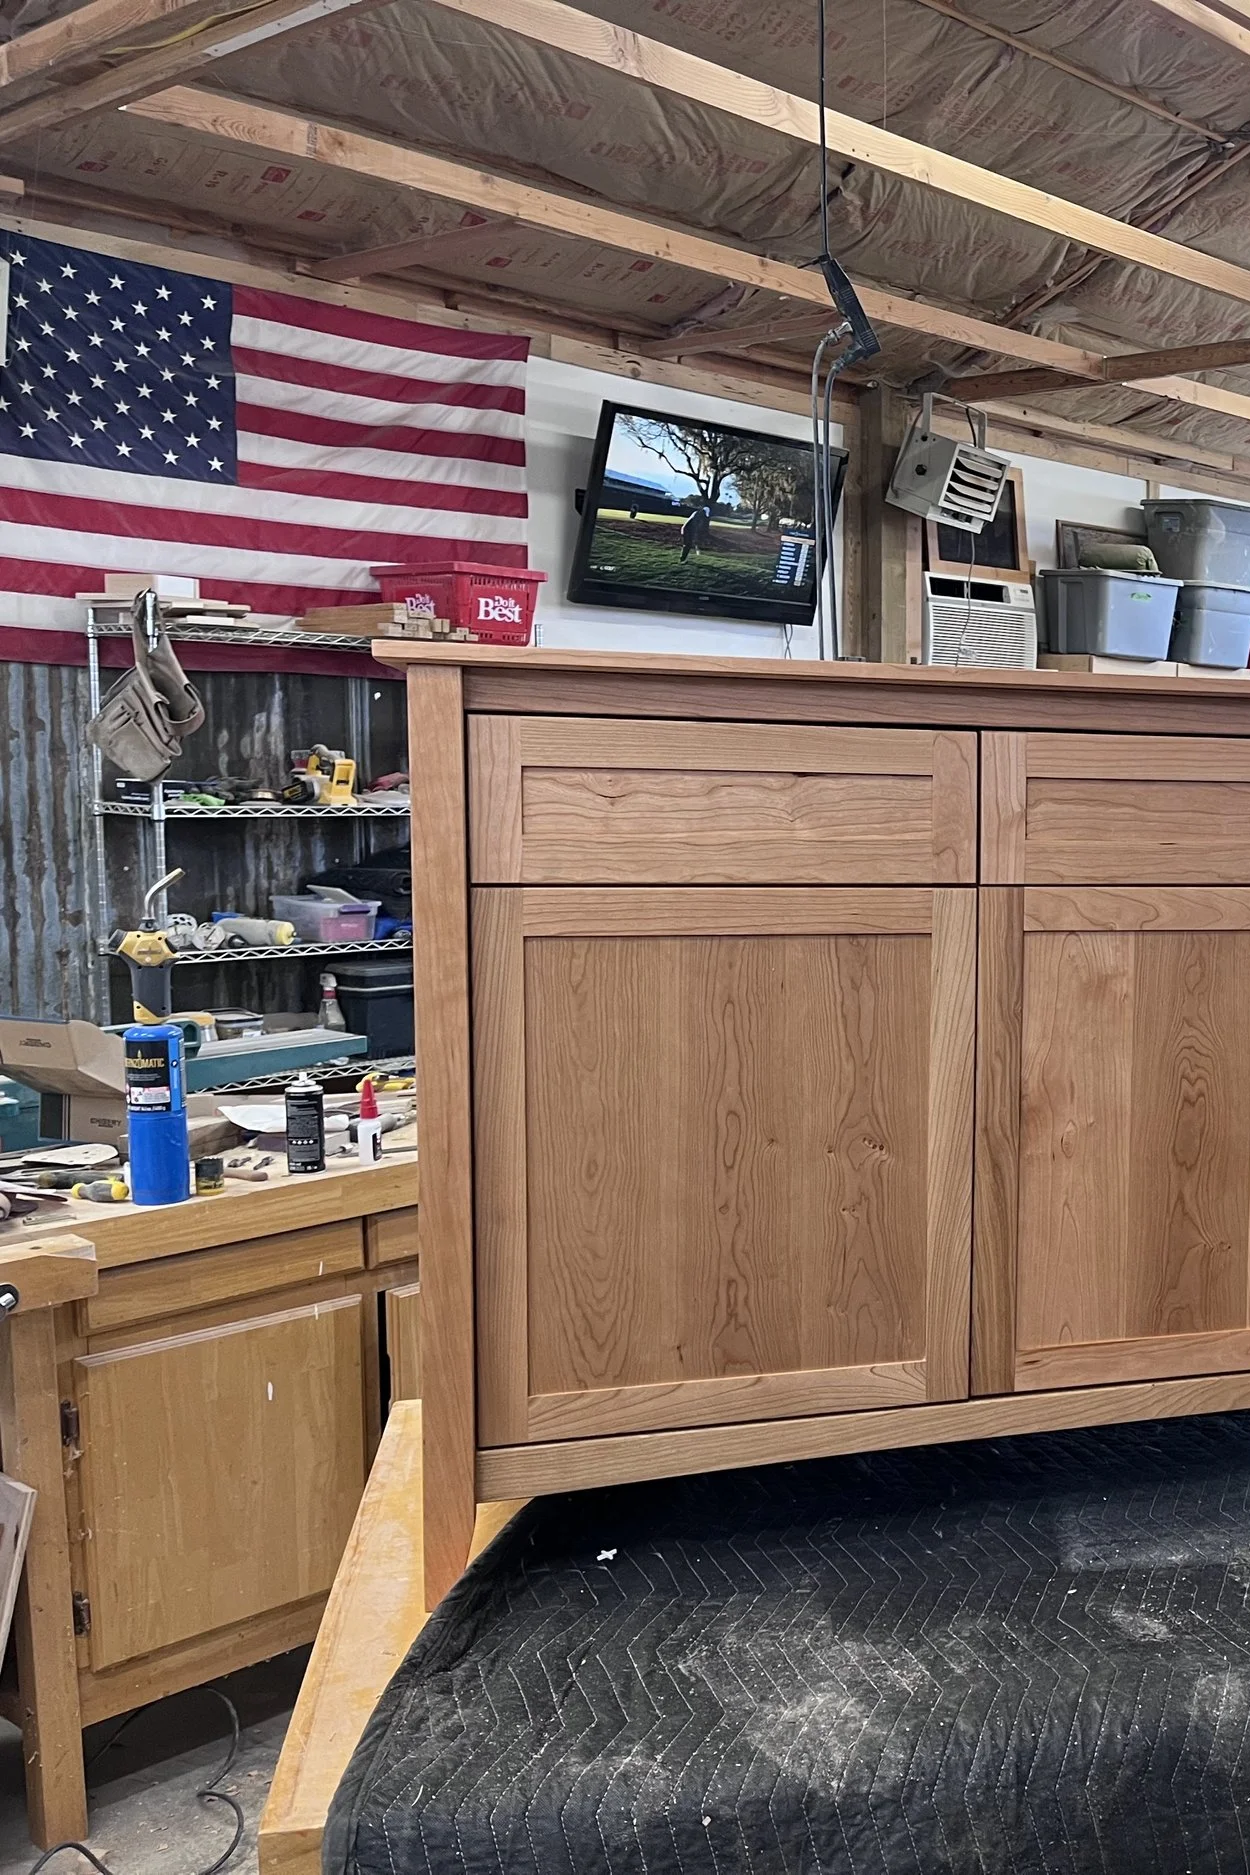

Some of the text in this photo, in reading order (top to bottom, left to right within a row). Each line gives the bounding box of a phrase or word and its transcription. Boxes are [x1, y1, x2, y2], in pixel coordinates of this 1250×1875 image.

[477, 597, 522, 623] Best
[494, 595, 515, 608] Do it
